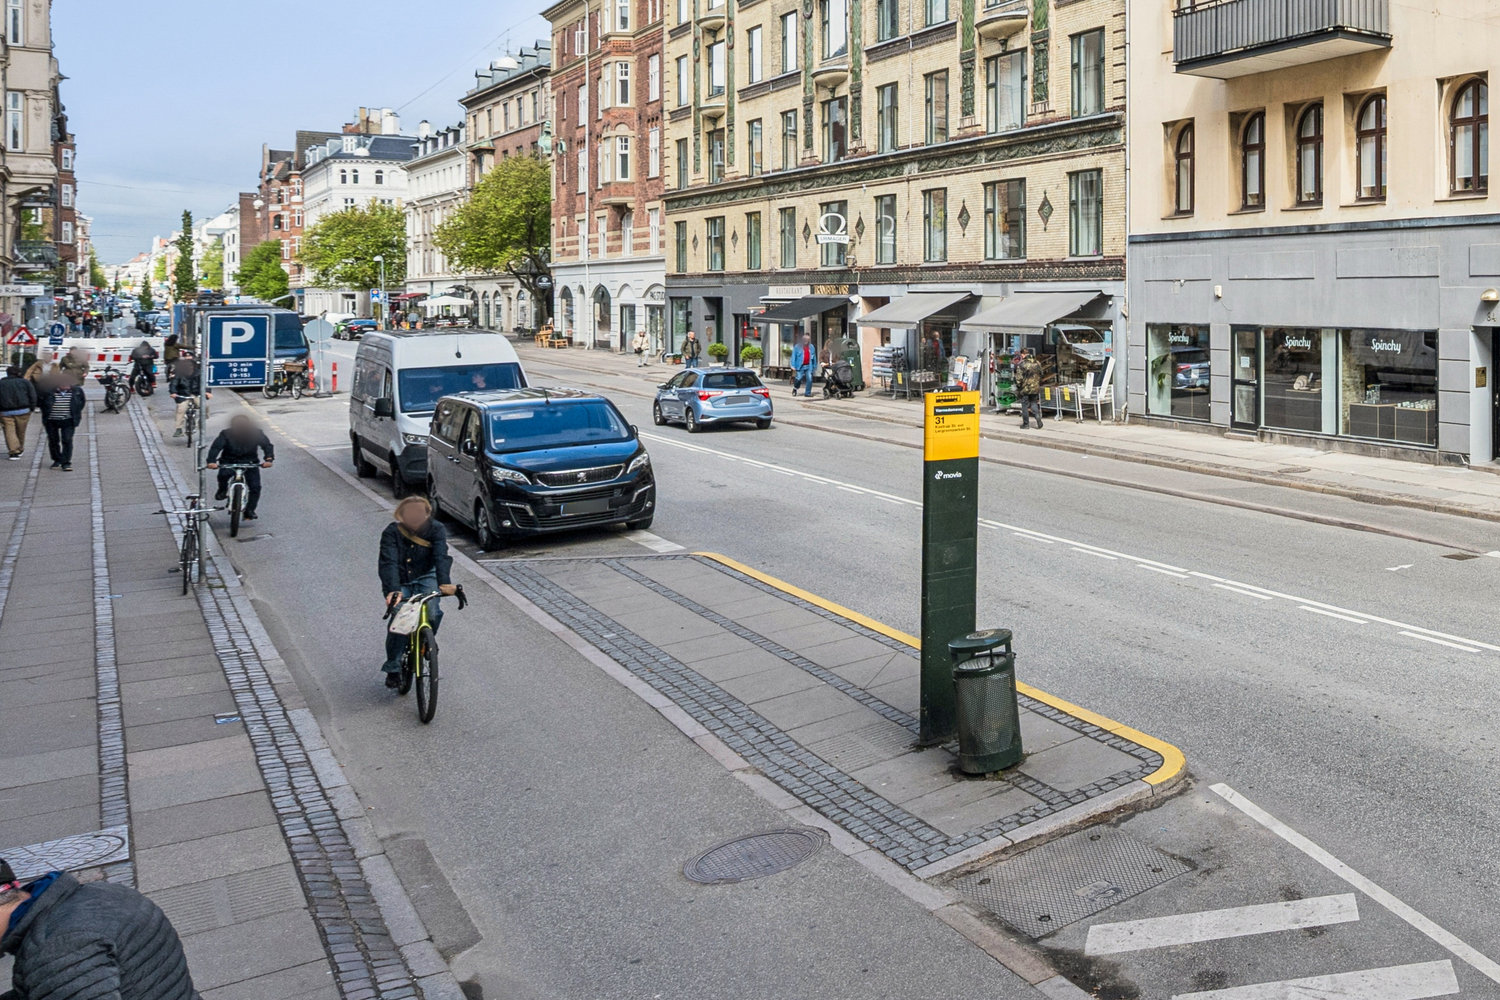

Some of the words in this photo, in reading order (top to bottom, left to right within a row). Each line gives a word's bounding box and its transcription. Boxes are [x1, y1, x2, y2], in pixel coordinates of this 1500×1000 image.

[222, 321, 255, 354] P
[1168, 331, 1190, 346] Spinchy
[1285, 336, 1311, 350] Spinchy
[1371, 338, 1401, 354] Spinchy
[935, 416, 945, 425] 31
